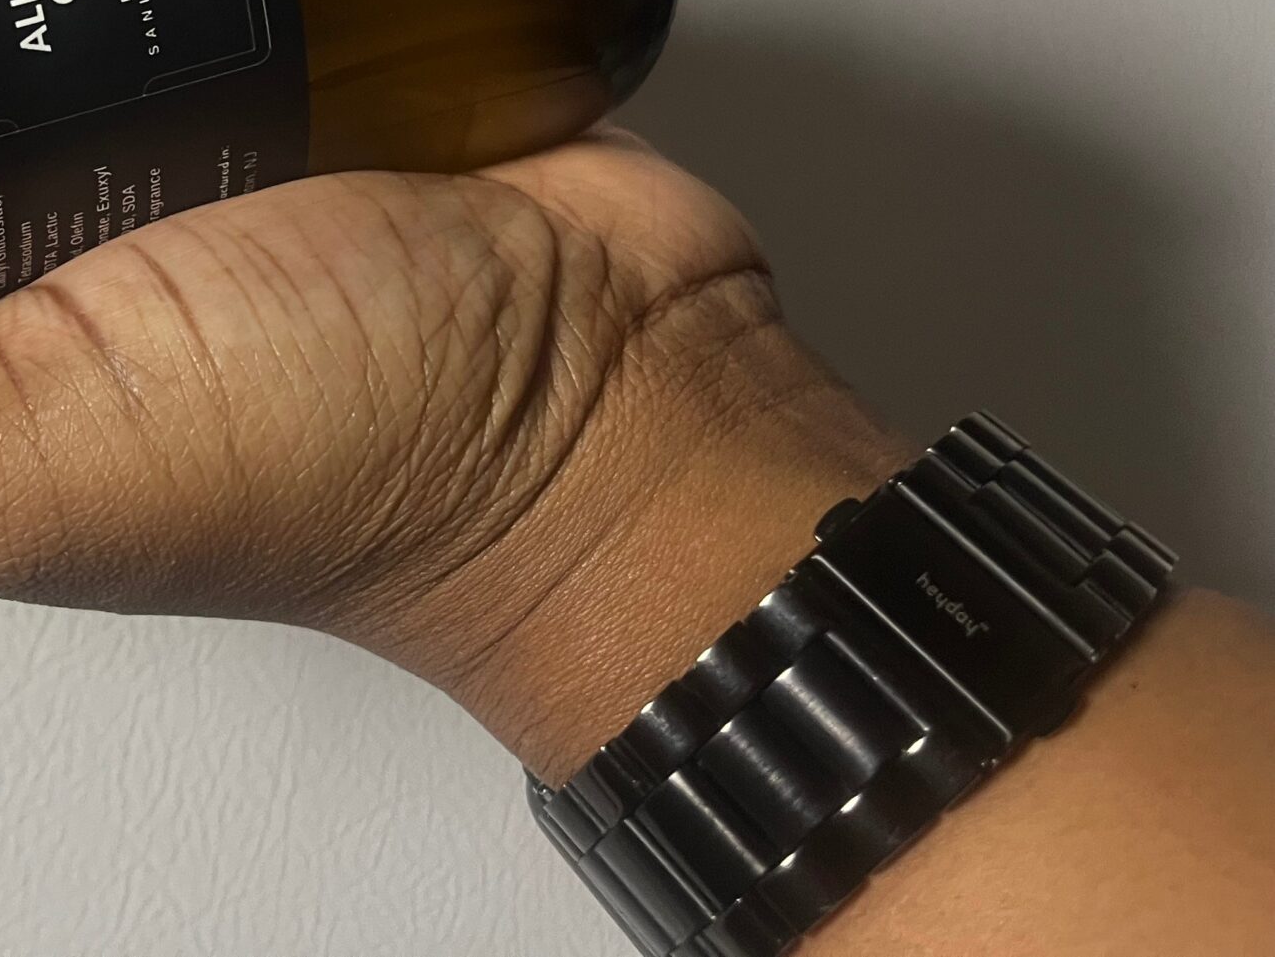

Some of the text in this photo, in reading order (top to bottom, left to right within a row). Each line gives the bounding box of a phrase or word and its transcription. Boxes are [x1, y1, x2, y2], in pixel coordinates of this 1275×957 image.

[121, 184, 136, 213] SDA
[150, 168, 164, 222] ragrance
[217, 161, 230, 199] actured
[70, 211, 84, 246] Olefin
[93, 166, 112, 245] onate, Exuxyl
[17, 221, 33, 283] Tetrasodium
